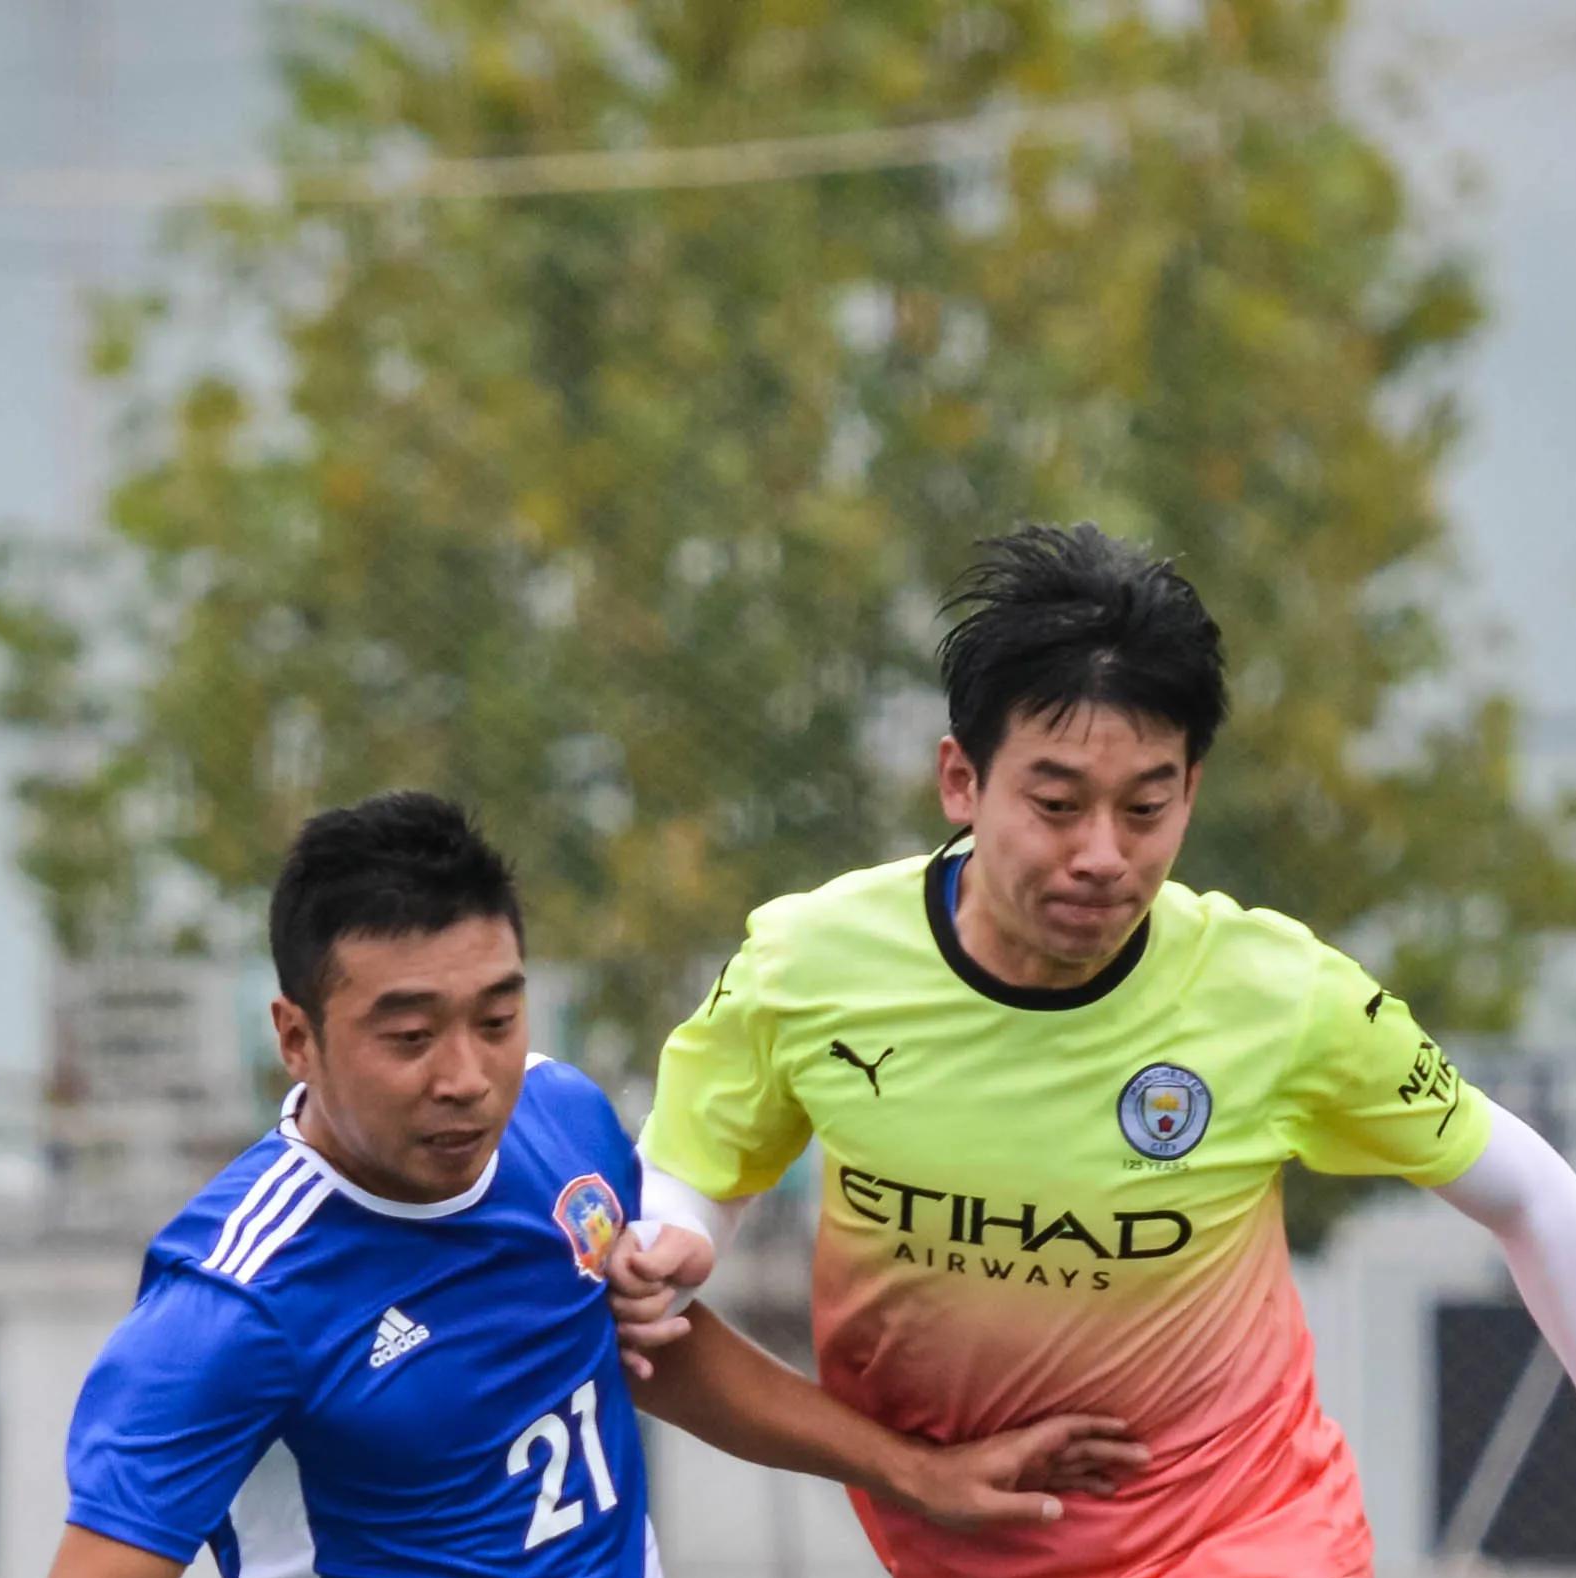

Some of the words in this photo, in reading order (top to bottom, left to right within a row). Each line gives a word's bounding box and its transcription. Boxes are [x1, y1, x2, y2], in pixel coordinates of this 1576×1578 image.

[839, 1165, 1193, 1260] ETIHAD
[893, 1242, 1112, 1291] AIRWAYS
[369, 1324, 431, 1369] adidas
[506, 1379, 618, 1551] 21
